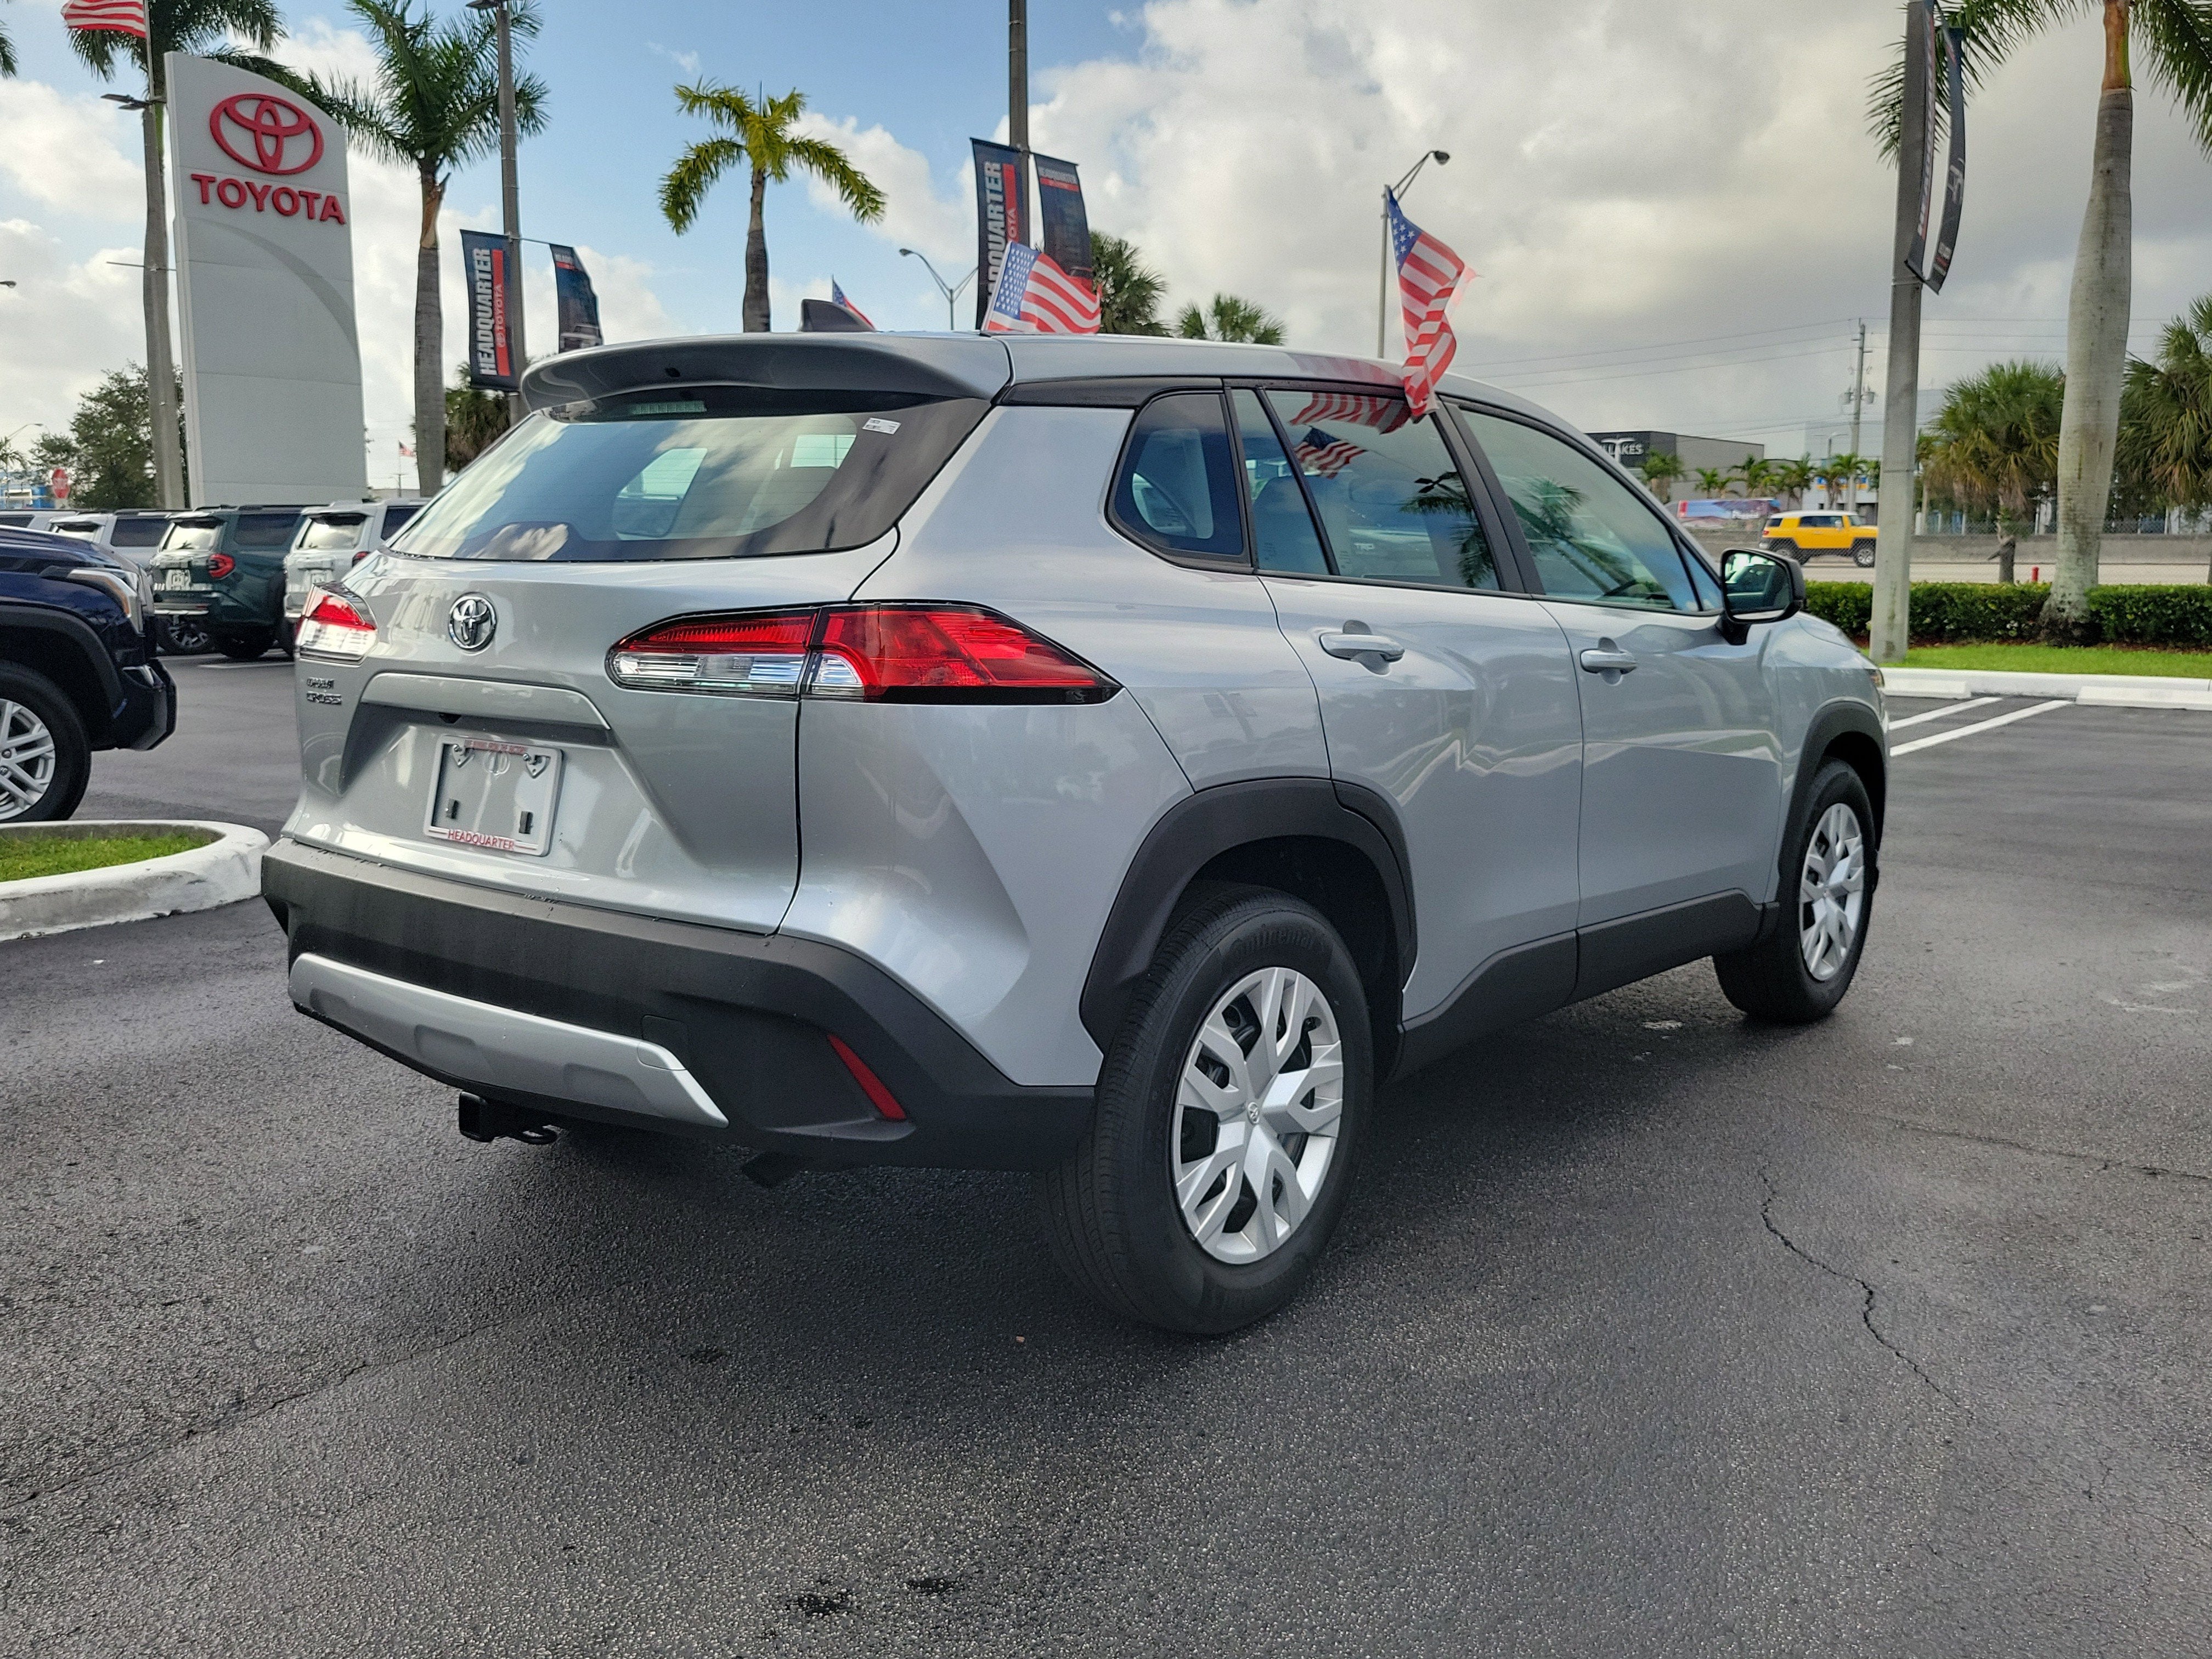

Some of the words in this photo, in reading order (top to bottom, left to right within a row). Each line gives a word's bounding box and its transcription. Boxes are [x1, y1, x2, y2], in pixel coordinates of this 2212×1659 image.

[190, 173, 346, 225] TOYOTA
[984, 162, 1006, 302] DQUARTER
[472, 248, 498, 375] HEADQUARTER
[494, 284, 505, 330] TOYOTA
[448, 829, 515, 851] HEADQUARTER
